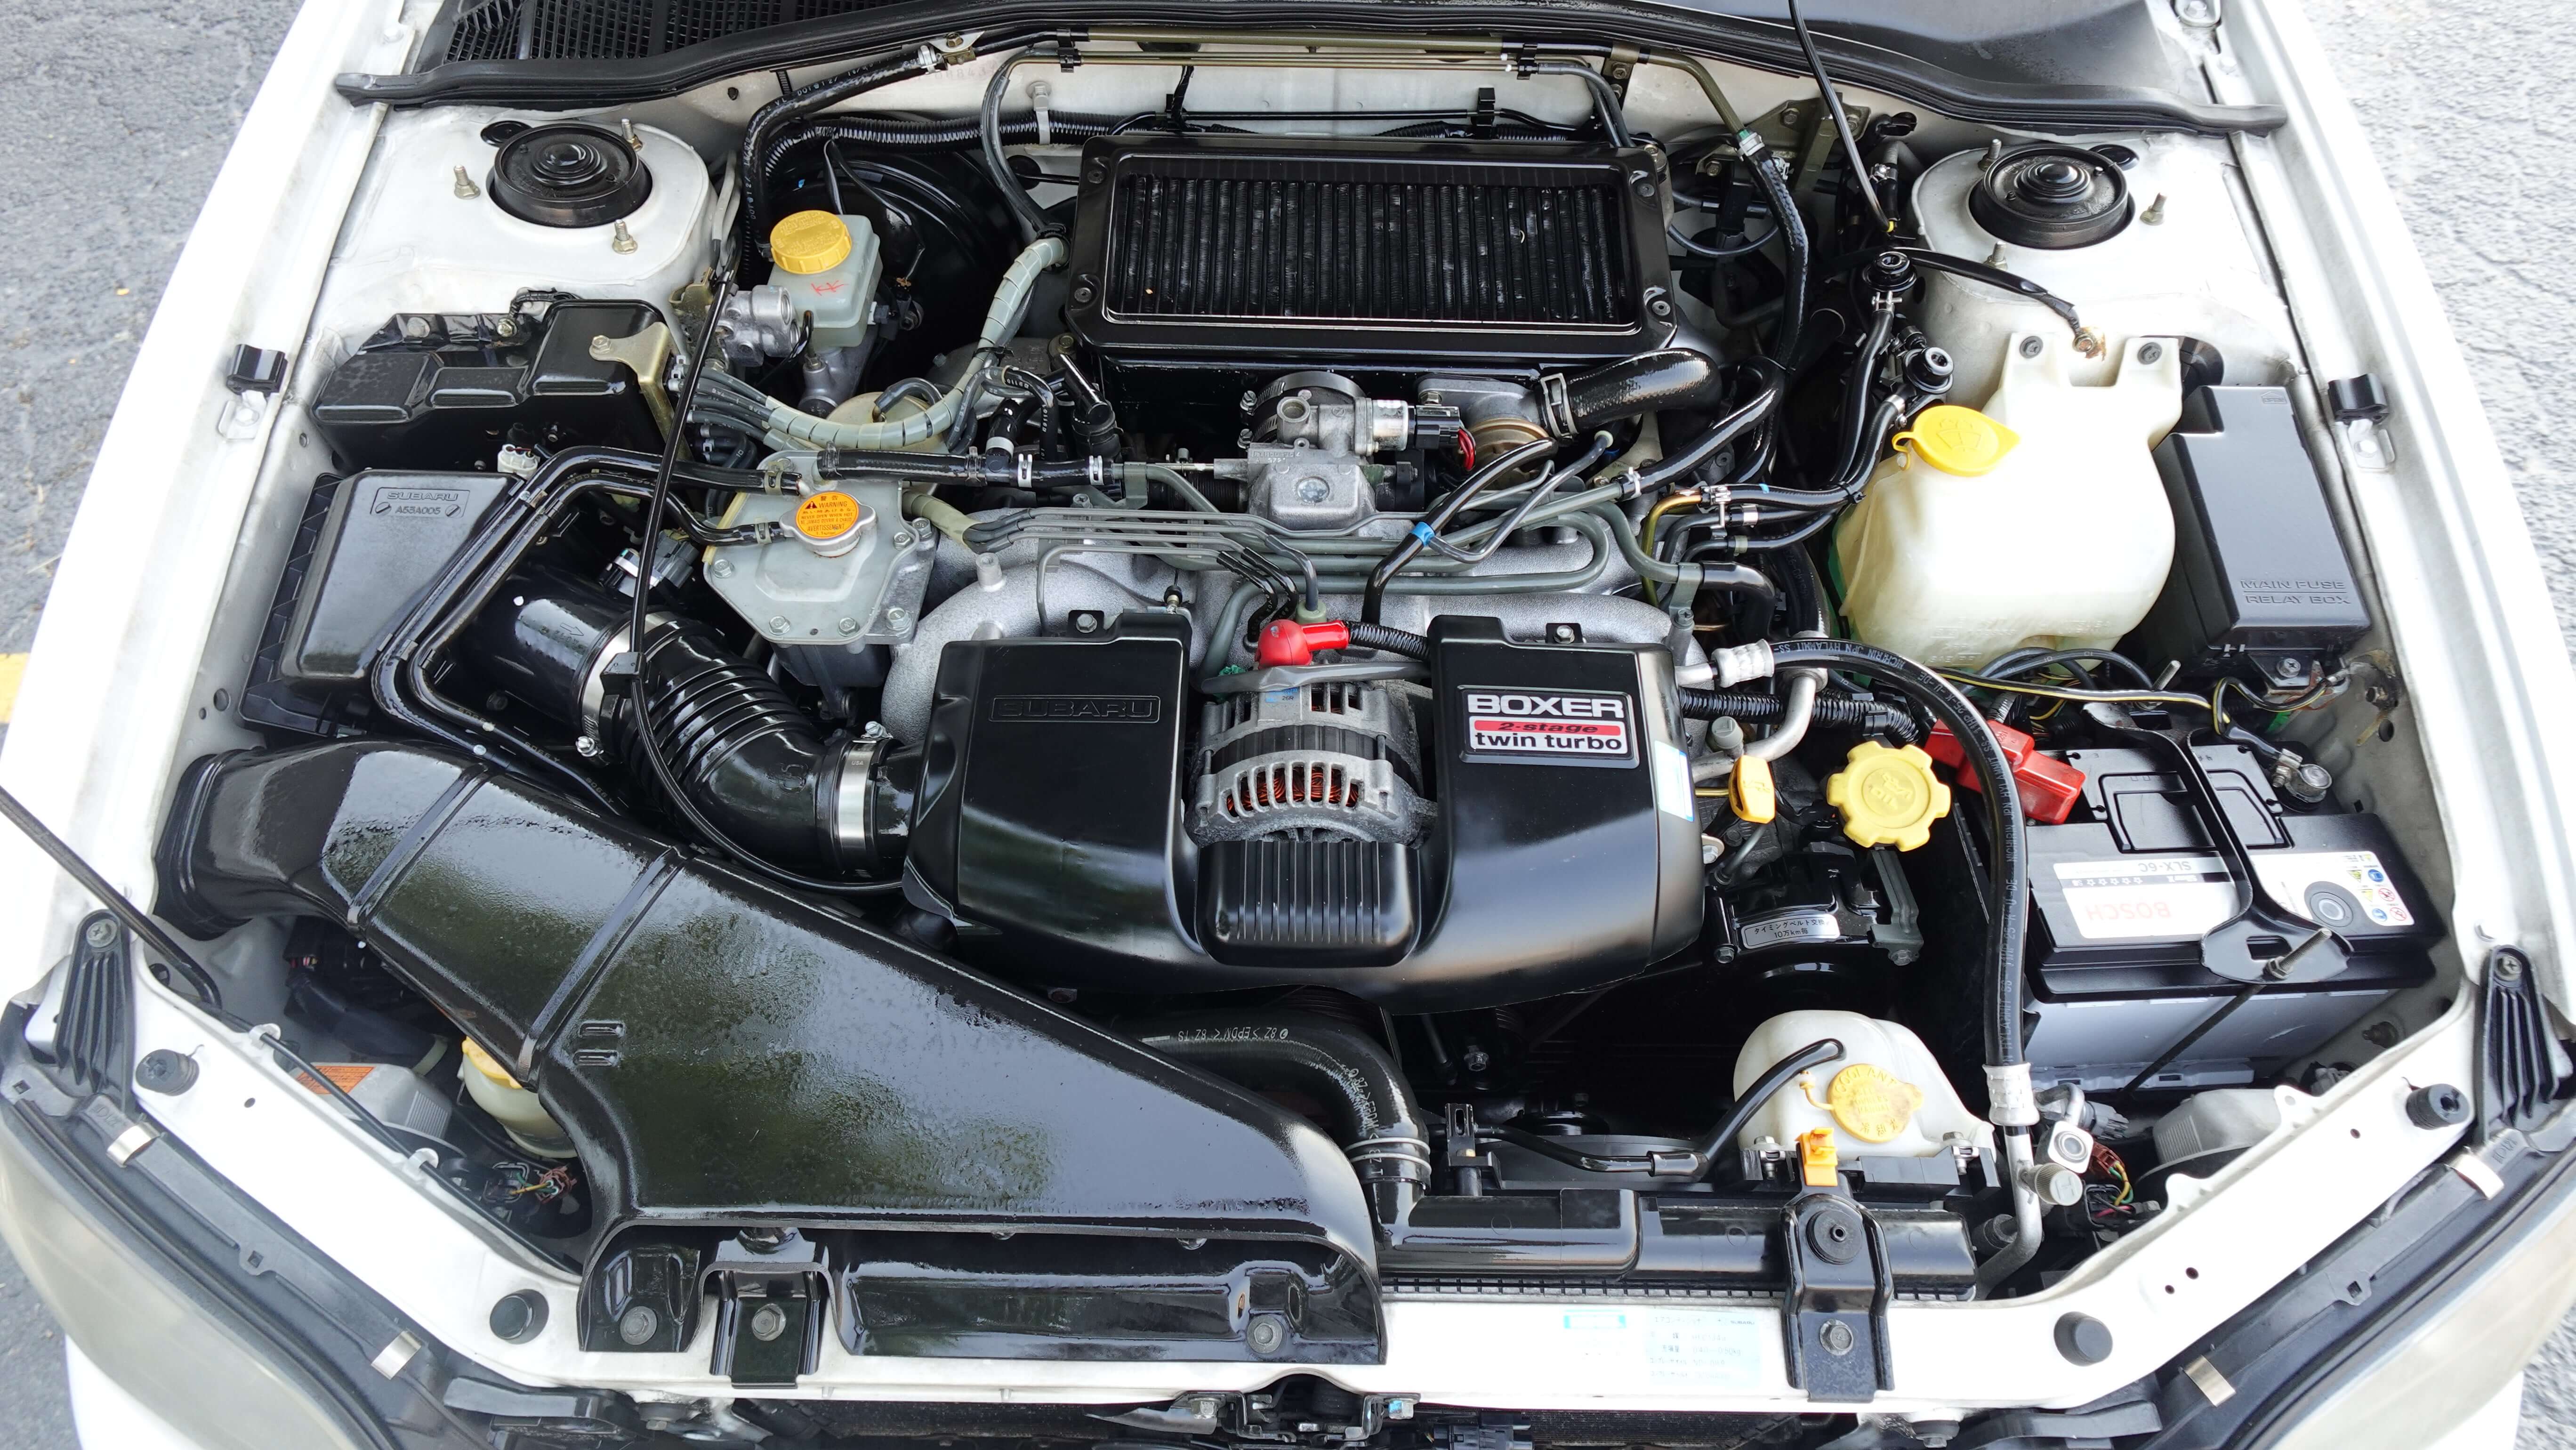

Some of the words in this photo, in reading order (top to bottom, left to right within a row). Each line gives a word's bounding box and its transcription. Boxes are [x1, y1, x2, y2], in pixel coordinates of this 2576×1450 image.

[387, 491, 459, 501] SUBARU
[807, 523, 845, 532] AVERTISSEMENT
[2240, 579, 2292, 589] MAIN
[2298, 580, 2346, 590] FUSE
[2246, 594, 2303, 604] RELAY
[2310, 594, 2351, 605] BOX
[1845, 643, 1864, 655] JPN
[998, 700, 1154, 718] SUBARU
[1467, 693, 1624, 718] BOXER
[1498, 722, 1598, 733] 2-stage
[1475, 732, 1537, 747] twin
[1544, 734, 1621, 750] turbo
[2004, 824, 2019, 862] NICHIRIN
[2138, 860, 2192, 872] SLX-6C
[2086, 902, 2171, 921] BOSCH
[1178, 1030, 1189, 1042] TS
